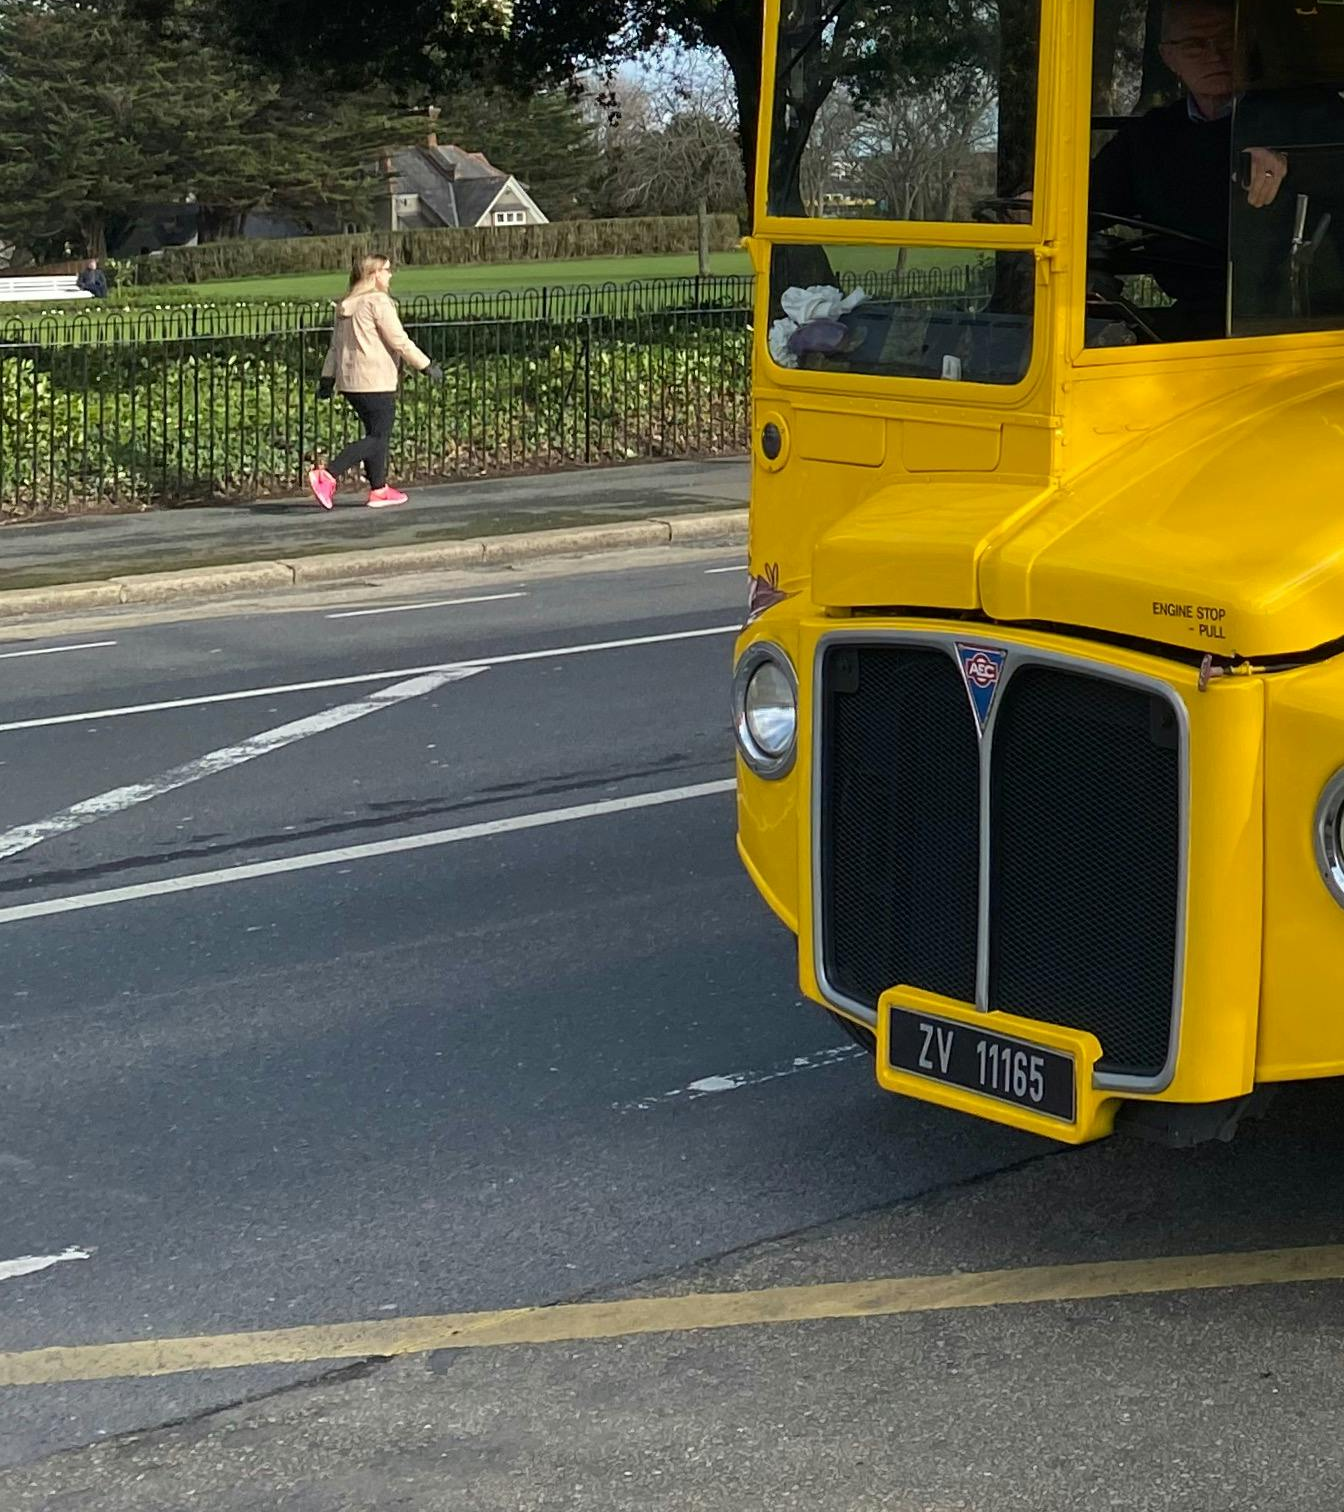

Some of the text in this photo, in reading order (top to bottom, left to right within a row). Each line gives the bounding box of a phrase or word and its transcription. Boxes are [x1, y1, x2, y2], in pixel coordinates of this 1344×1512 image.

[1152, 602, 1226, 621] ENGINE STOP
[1199, 623, 1226, 639] PULL
[968, 662, 995, 678] AEC
[918, 1023, 1045, 1102] ZV 11165
